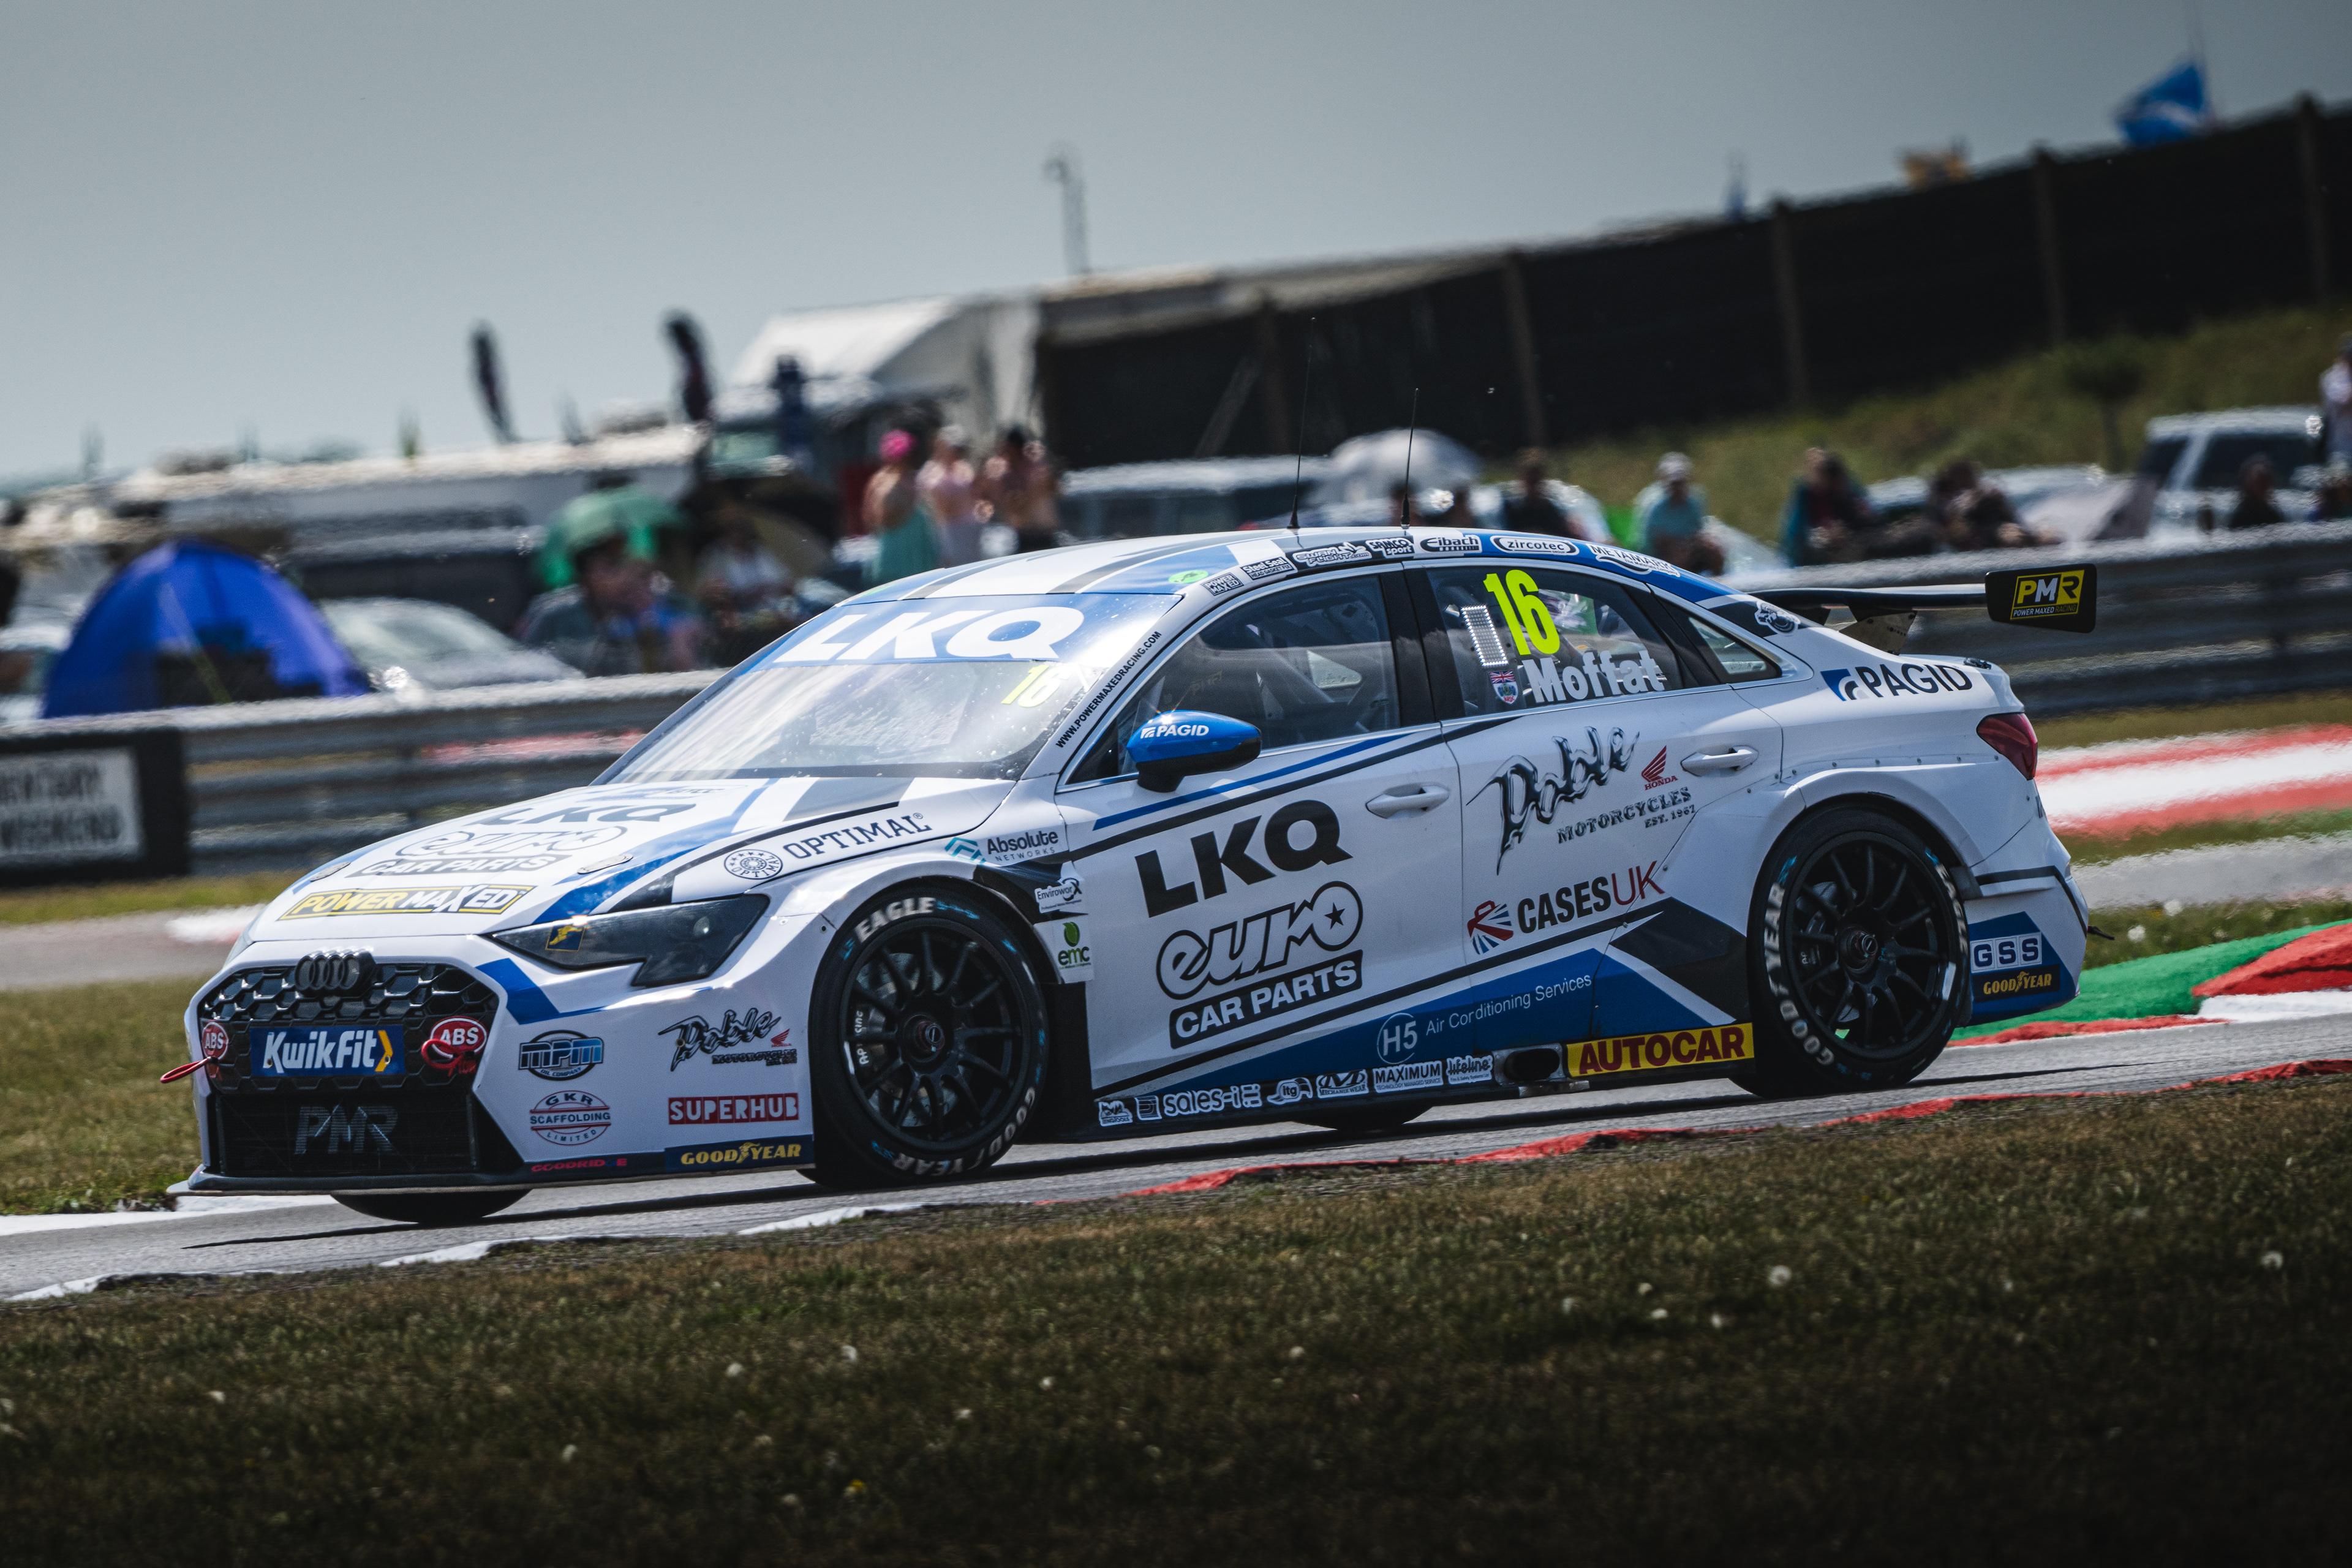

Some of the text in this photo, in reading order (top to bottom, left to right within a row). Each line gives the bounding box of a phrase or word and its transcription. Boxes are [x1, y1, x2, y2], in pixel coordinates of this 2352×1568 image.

[1297, 549, 1337, 560] SWAN
[1369, 538, 1408, 549] SAMCO
[1387, 546, 1412, 556] sport
[1420, 537, 1479, 551] Eibach
[1507, 540, 1564, 551] zircotec
[1243, 558, 1287, 574] Steel Seal
[1590, 545, 1673, 571] METAMARK
[1204, 575, 1235, 589] POWER
[1210, 579, 1240, 594] MAXED
[2017, 575, 2080, 604] PMR
[1483, 569, 1560, 655] 16
[2013, 608, 2035, 617] POWER
[2034, 606, 2054, 616] MAXED
[774, 606, 1084, 663] LKQ
[1001, 664, 1073, 707] 16
[1521, 650, 1665, 704] Moffat
[1859, 663, 1973, 698] PAGID
[1055, 631, 1163, 748] WWW.POWERMAXEDRACING.COM
[1156, 724, 1210, 737] PAGID
[1644, 775, 1678, 790] HONDA
[463, 803, 696, 826] LKQ
[1558, 786, 1692, 844] MOTORCYCLES
[1644, 804, 1696, 828] EST. 1967
[783, 815, 933, 859] OPTIMAL
[987, 831, 1058, 854] Absolute
[995, 846, 1055, 861] NETWORKS
[1134, 799, 1354, 918] LKQ
[361, 857, 557, 875] CAR PARTS
[731, 855, 781, 878] OPTIMAL
[295, 886, 511, 914] POWER MAXED
[857, 897, 937, 943] EAGLE
[1156, 880, 1363, 1000] euro
[1058, 946, 1090, 966] emc
[1973, 938, 2038, 967] GSS
[1983, 973, 2052, 995] GOODYEAR
[1175, 960, 1357, 1038] CAR PARTS
[1382, 1020, 1418, 1056] H5
[1426, 1018, 1445, 1036] Air
[1535, 974, 1592, 1001] Services
[204, 1031, 224, 1049] ABS
[440, 1027, 478, 1047] ABS
[1578, 1027, 1747, 1076] AUTOCAR
[552, 1066, 582, 1077] COMPANY
[1376, 1064, 1441, 1084] MAXIMUM
[546, 1093, 593, 1106] GKR
[1283, 1085, 1297, 1097] itg
[530, 1112, 611, 1125] SCAFFOLDING
[670, 1095, 797, 1121] SUPERHUB
[295, 1104, 399, 1156] PMR
[547, 1129, 597, 1142] LIMITED
[680, 1144, 801, 1165] GOODYEAR
